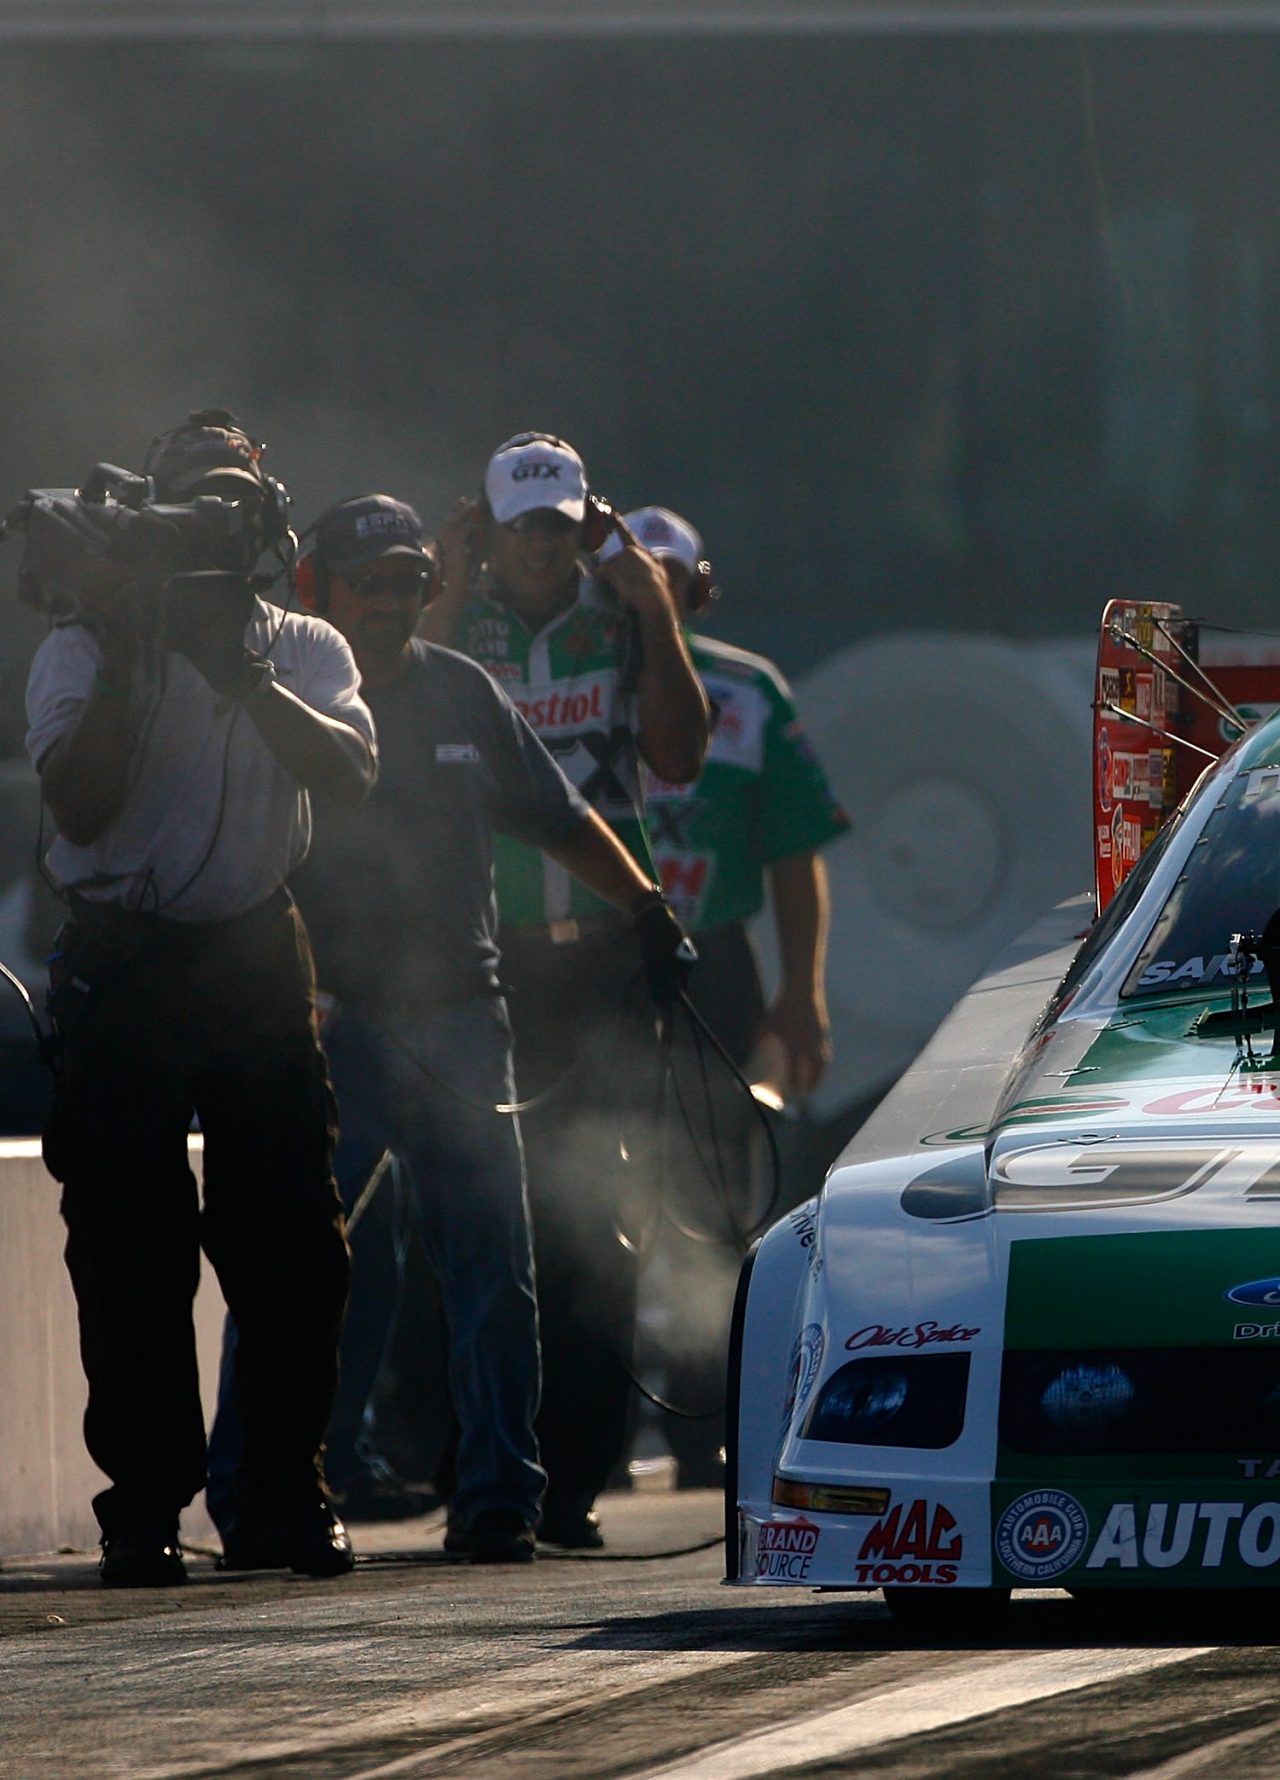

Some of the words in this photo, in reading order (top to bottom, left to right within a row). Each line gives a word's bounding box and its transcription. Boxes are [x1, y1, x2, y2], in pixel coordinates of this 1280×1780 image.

[511, 463, 562, 482] GTX
[512, 682, 604, 728] astrol
[844, 1325, 909, 1351] Old
[896, 1321, 982, 1349] Spice
[1003, 1493, 1066, 1530] AUTOMOBILE
[1064, 1503, 1083, 1531] CLUB
[760, 1527, 817, 1552] BRAND
[858, 1499, 963, 1560] MAC
[1020, 1524, 1062, 1546] AAA
[1000, 1539, 1036, 1576] SOUTHERN
[855, 1563, 959, 1585] TOOLS
